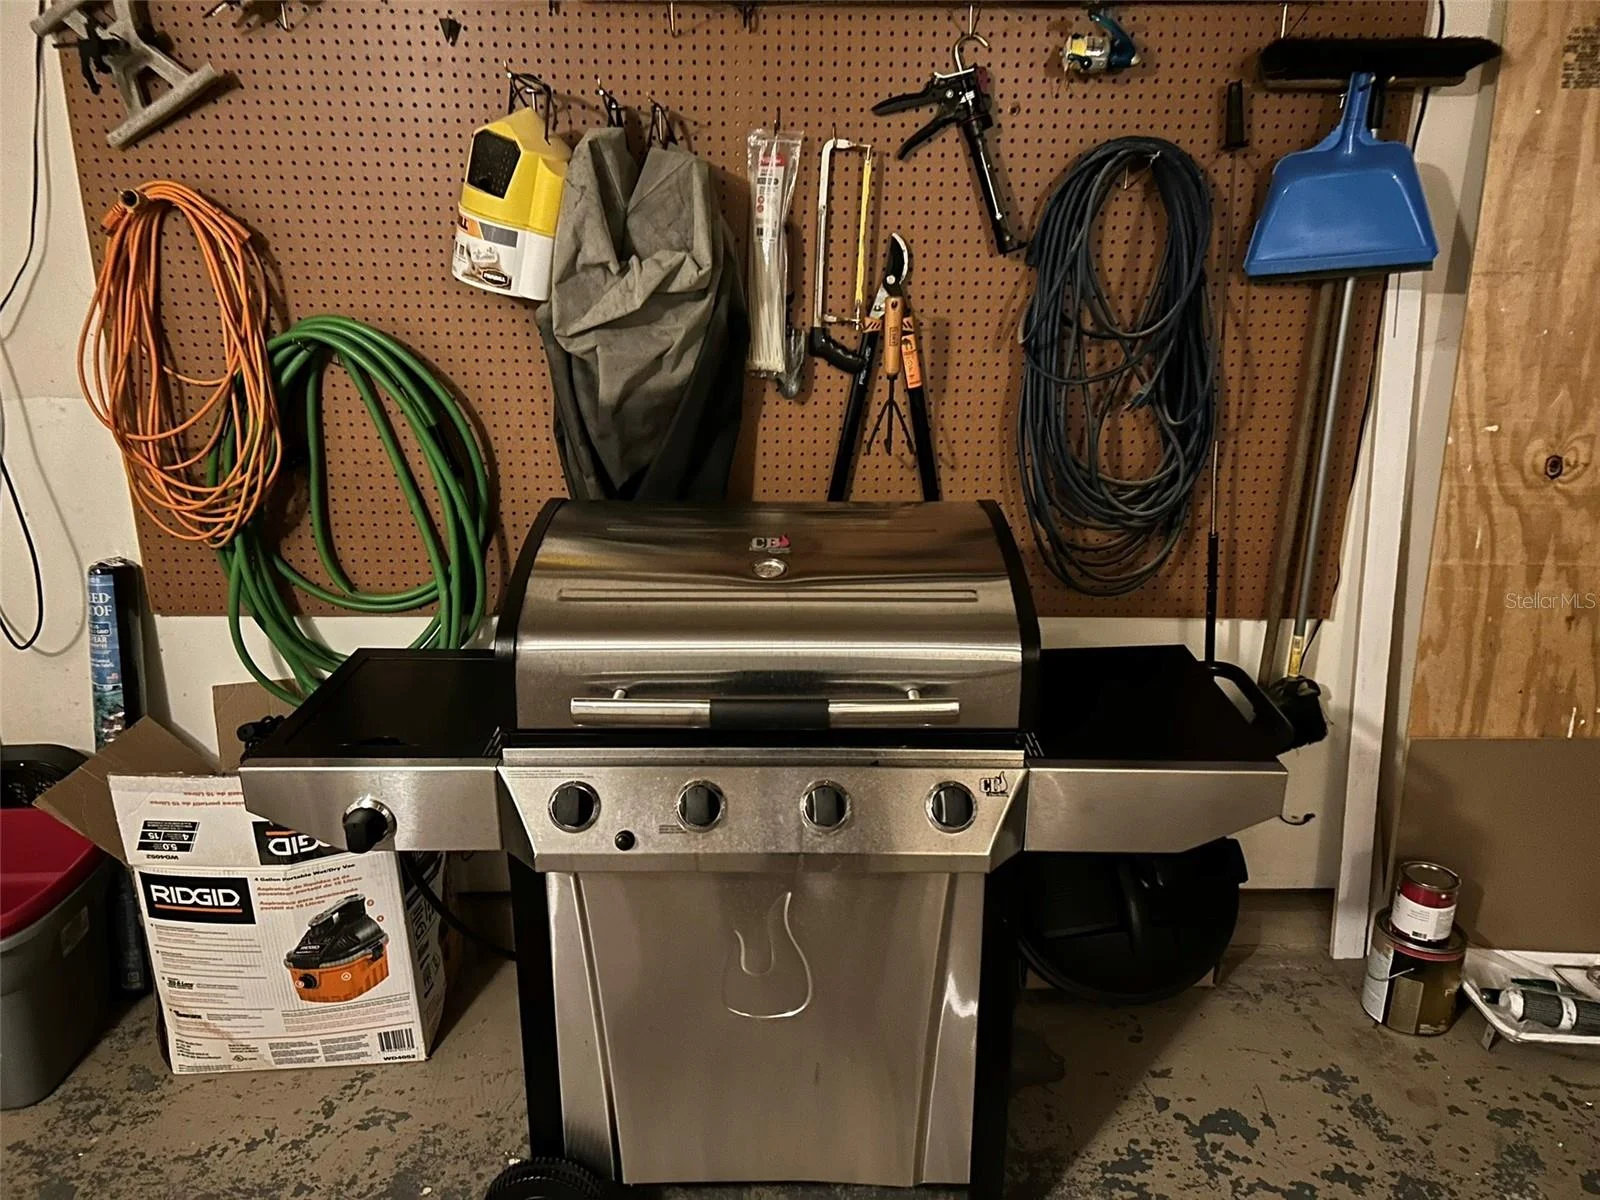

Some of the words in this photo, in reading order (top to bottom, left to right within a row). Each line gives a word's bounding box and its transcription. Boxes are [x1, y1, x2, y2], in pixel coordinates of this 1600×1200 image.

[90, 592, 112, 604] ED
[92, 605, 113, 617] OF
[148, 832, 160, 840] 15
[182, 833, 190, 841] 4
[162, 843, 178, 851] 5.0
[268, 834, 331, 856] GID
[282, 873, 312, 882] Portable
[313, 867, 341, 875] Wet/Dry
[150, 884, 241, 907] RIDGID
